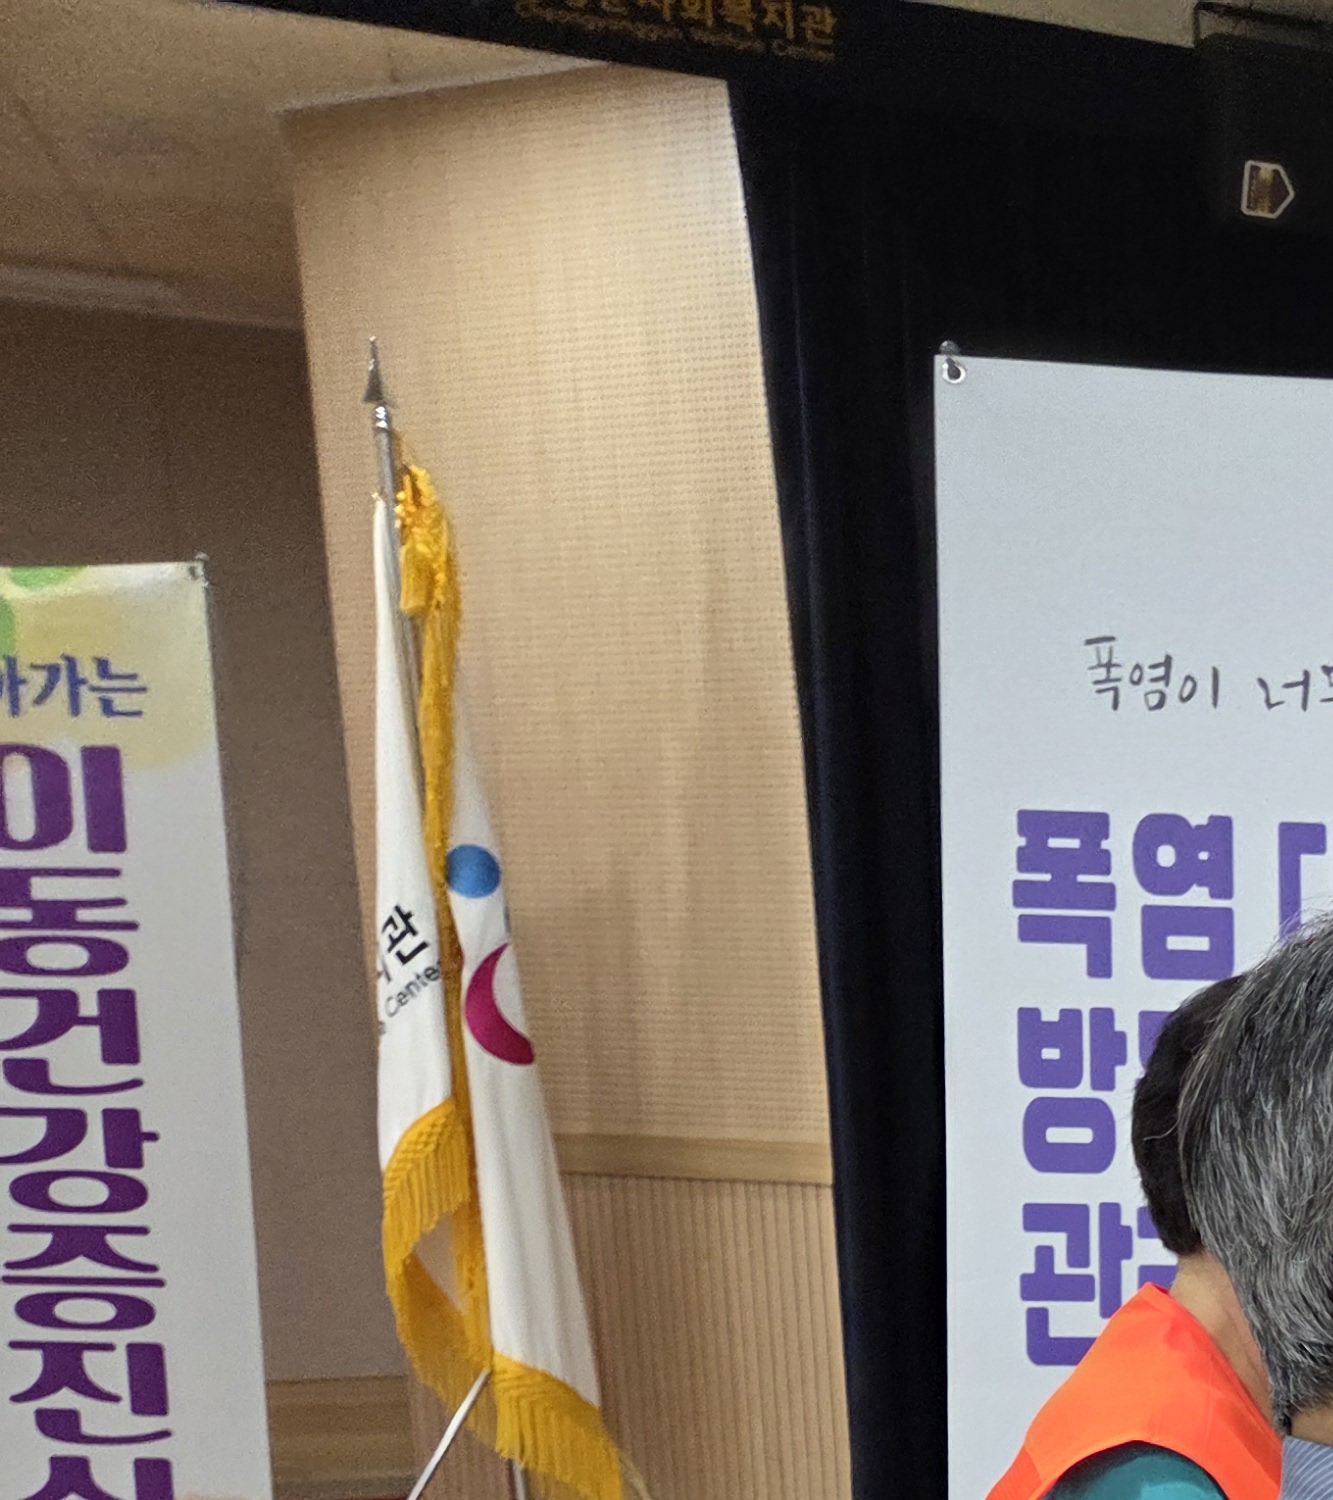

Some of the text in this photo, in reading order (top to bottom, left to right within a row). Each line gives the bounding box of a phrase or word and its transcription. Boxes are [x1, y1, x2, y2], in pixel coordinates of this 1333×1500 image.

[1084, 636, 1220, 712] 폭염이
[1012, 809, 1235, 981] 폭염
[384, 957, 442, 1019] Cente
[1018, 1006, 1165, 1174] 방
